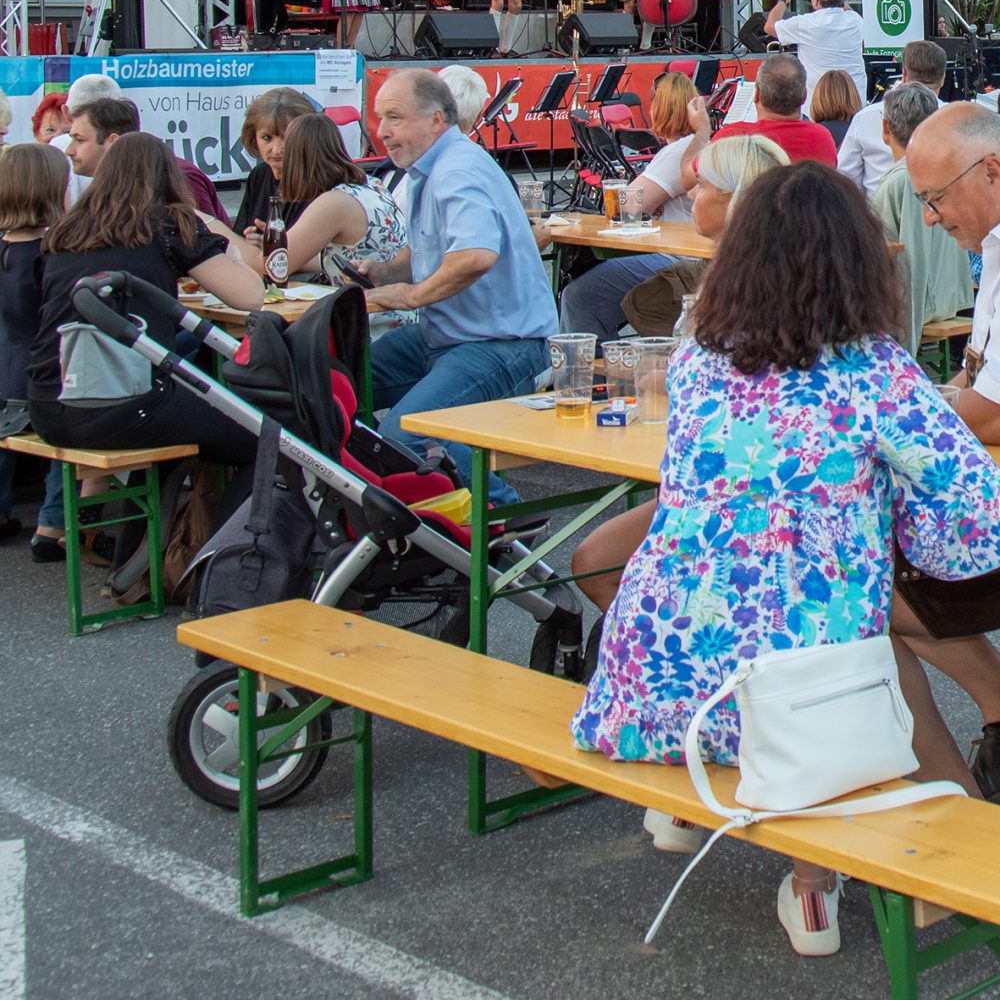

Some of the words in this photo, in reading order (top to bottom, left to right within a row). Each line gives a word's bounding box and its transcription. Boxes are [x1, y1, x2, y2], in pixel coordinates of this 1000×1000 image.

[102, 58, 254, 80] Holzbaumeister
[148, 97, 181, 111] von
[186, 92, 230, 111] Haus
